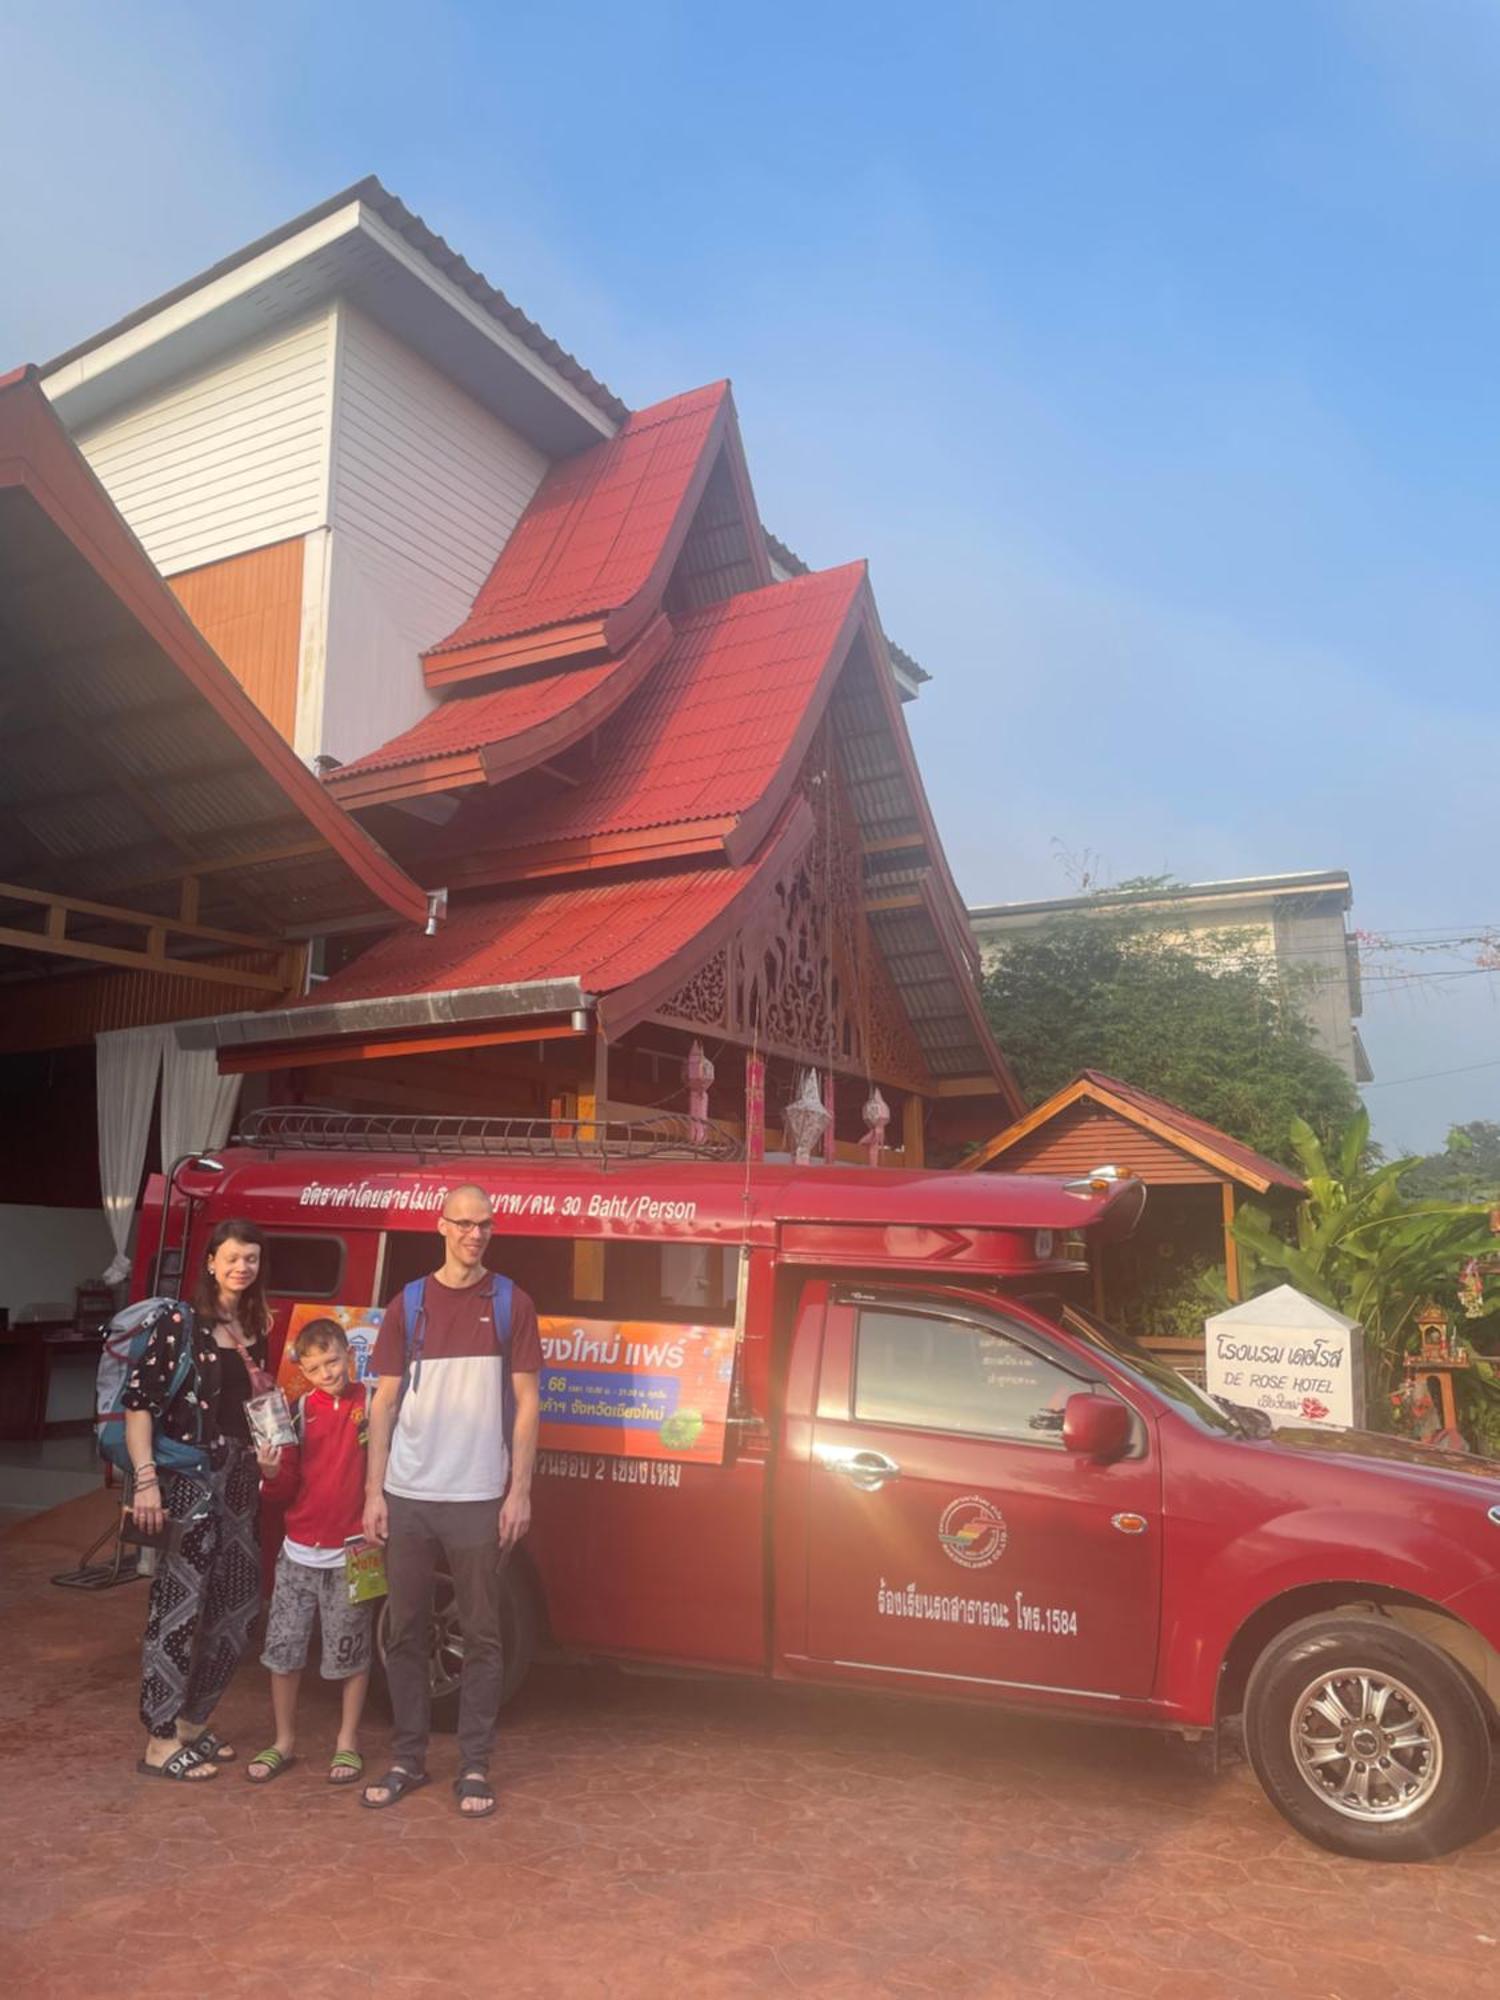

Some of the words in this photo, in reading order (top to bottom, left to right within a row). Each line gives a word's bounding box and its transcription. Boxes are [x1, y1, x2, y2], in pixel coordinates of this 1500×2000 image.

[300, 1181, 448, 1211] อัตราค่าโดยสารไม่เกิ
[561, 1196, 581, 1216] 30
[588, 1194, 696, 1220] Baht/Person
[625, 1338, 687, 1369] แฟร์
[1216, 1334, 1283, 1364] โรงแรม
[548, 1376, 567, 1392] 66
[1224, 1372, 1244, 1387] DE
[1251, 1375, 1289, 1390] ROSE
[1293, 1379, 1334, 1394] HOTEL
[595, 1457, 606, 1481] 2
[1015, 1591, 1077, 1636] โทร.1584
